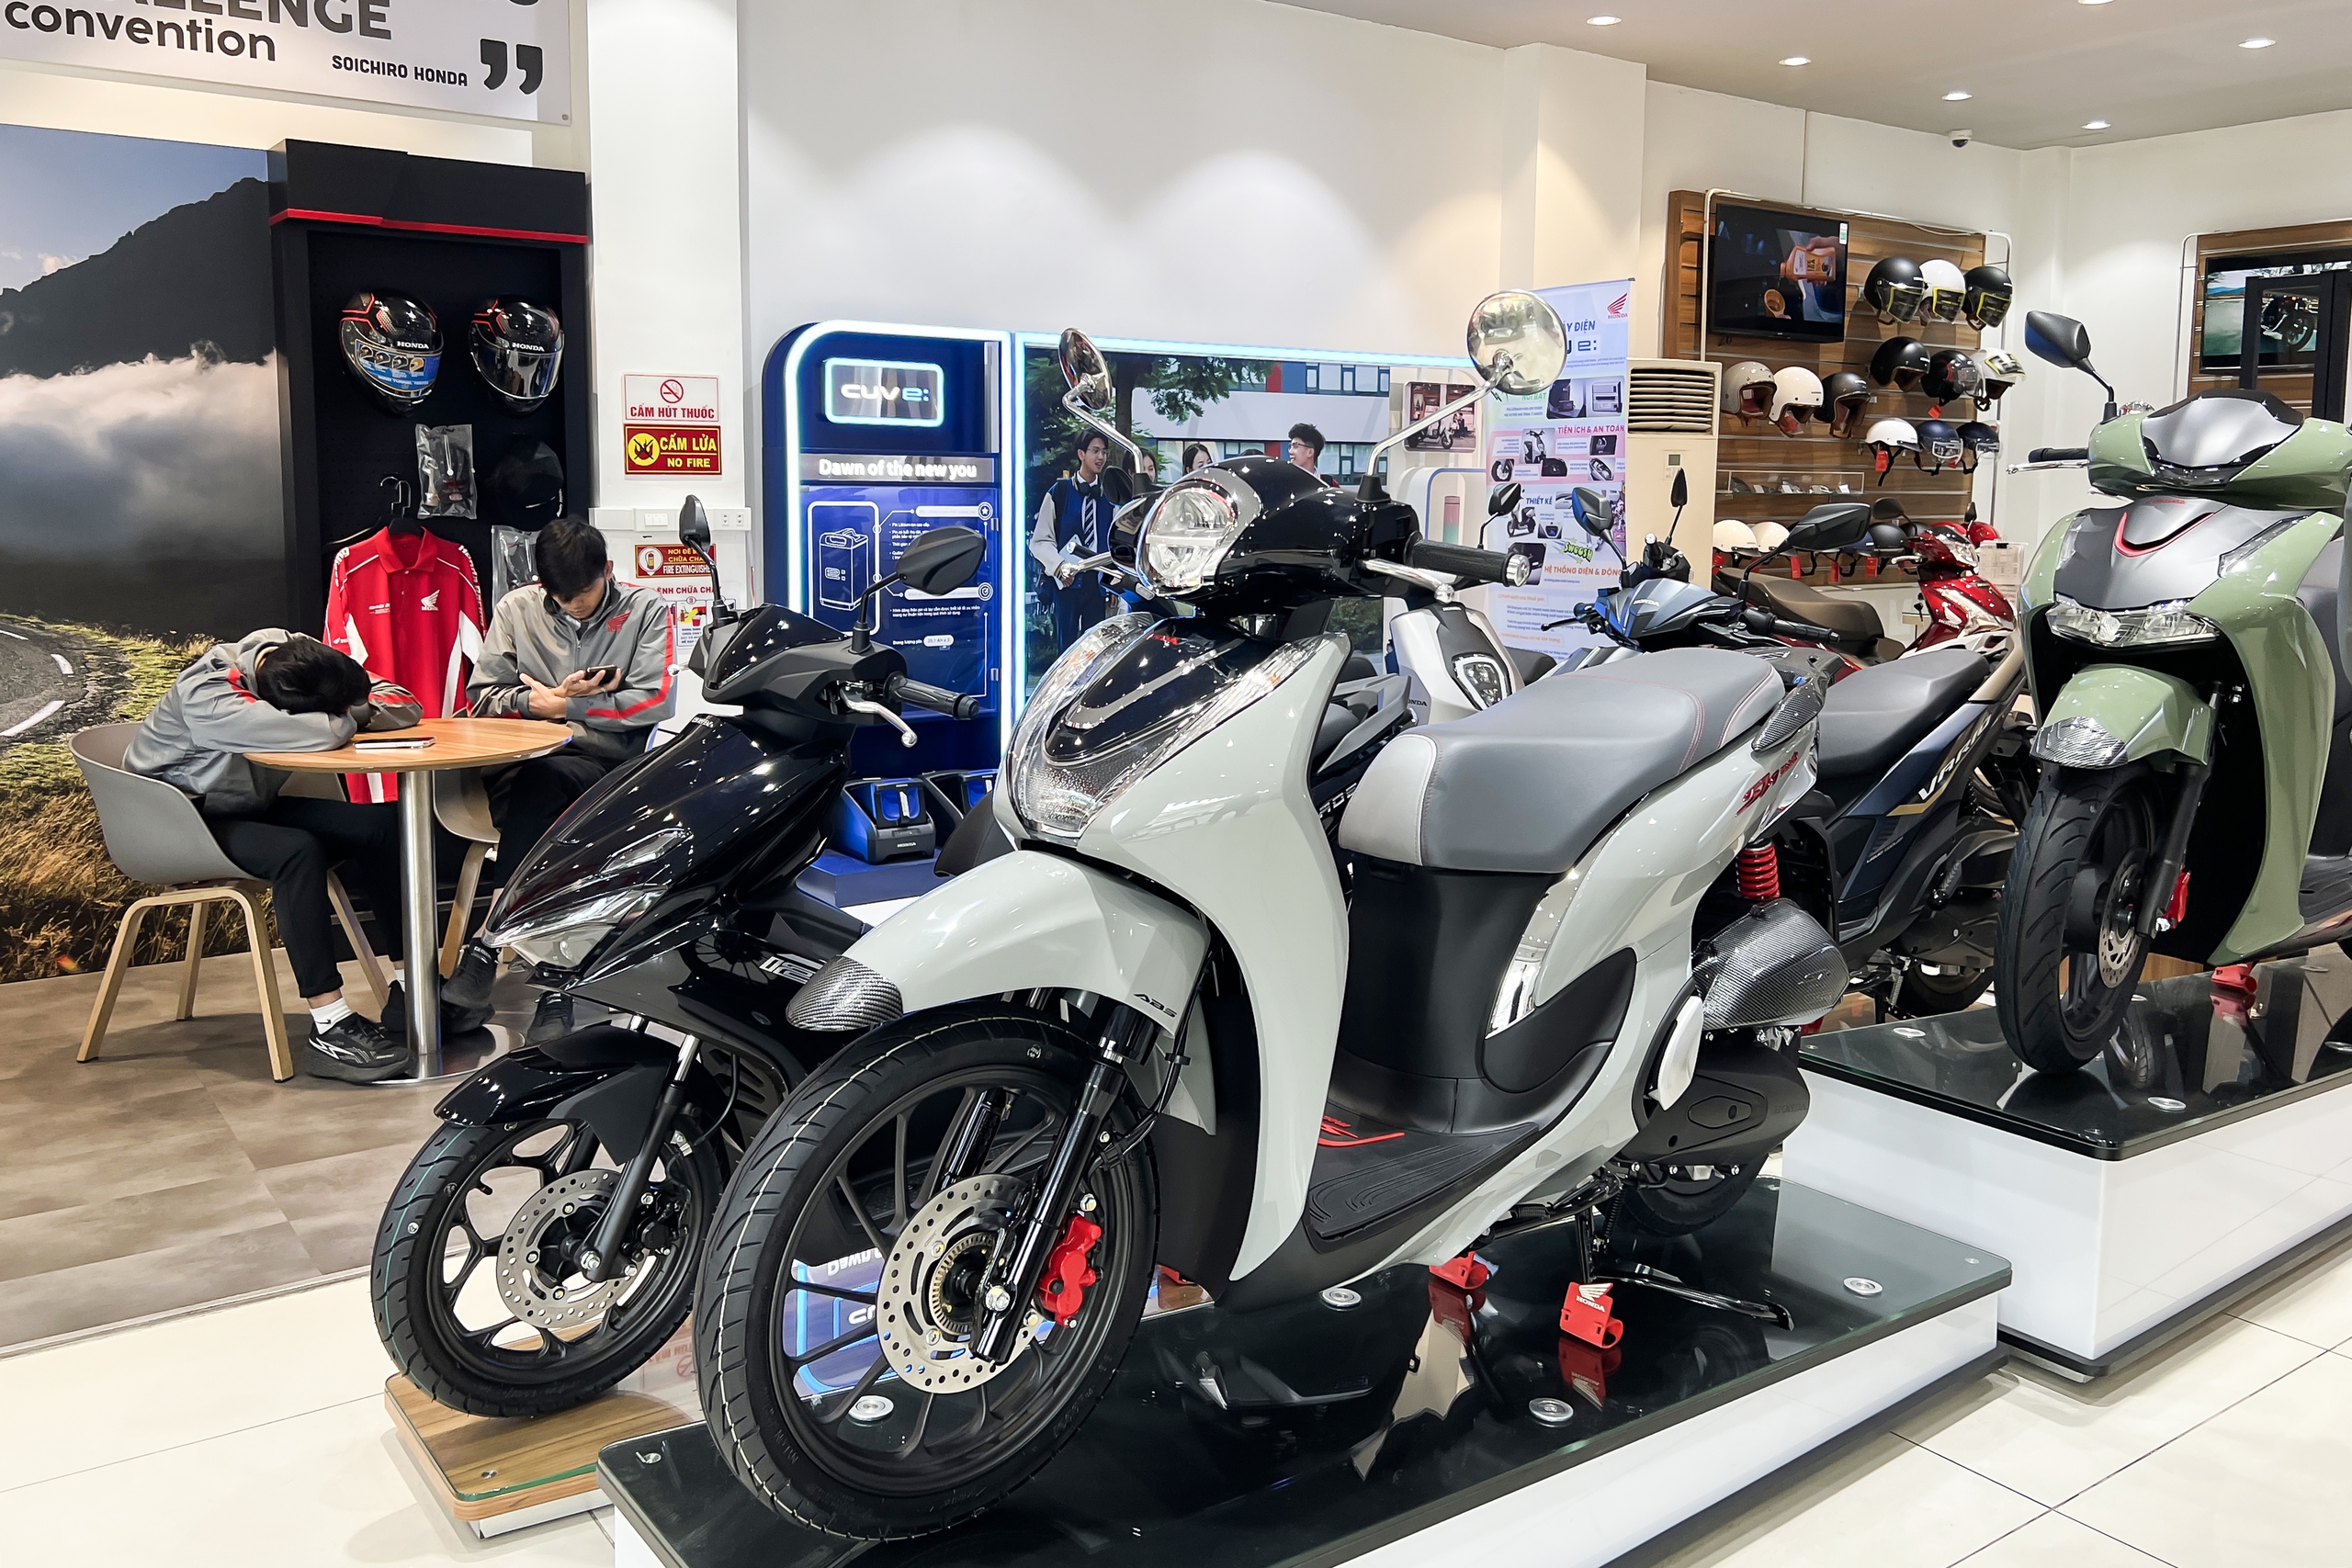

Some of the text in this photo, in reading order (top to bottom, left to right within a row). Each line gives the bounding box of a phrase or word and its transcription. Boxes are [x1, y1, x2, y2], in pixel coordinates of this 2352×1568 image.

[5, 1, 276, 62] convention
[332, 55, 468, 86] SOICHIRO HONDA
[397, 341, 429, 349] HONDA
[512, 342, 545, 352] HONDA
[630, 403, 715, 418] CẤM HÚT THUỐC
[660, 433, 717, 451] CẤM LỬA
[667, 457, 710, 468] NO FIRE
[819, 458, 977, 480] Dawn of the new you
[1525, 495, 1554, 505] THIẾT KẾ
[662, 565, 711, 574] FIRE EXTINGUISHE
[1554, 564, 1577, 574] THỐNG
[1577, 566, 1594, 576] ĐIỆN
[676, 585, 698, 593] CHỮA
[1634, 599, 1660, 607] HONDA
[1918, 714, 1992, 801] VARIO
[1133, 993, 1177, 1018] ABS
[1576, 1296, 1606, 1313] HONDA
